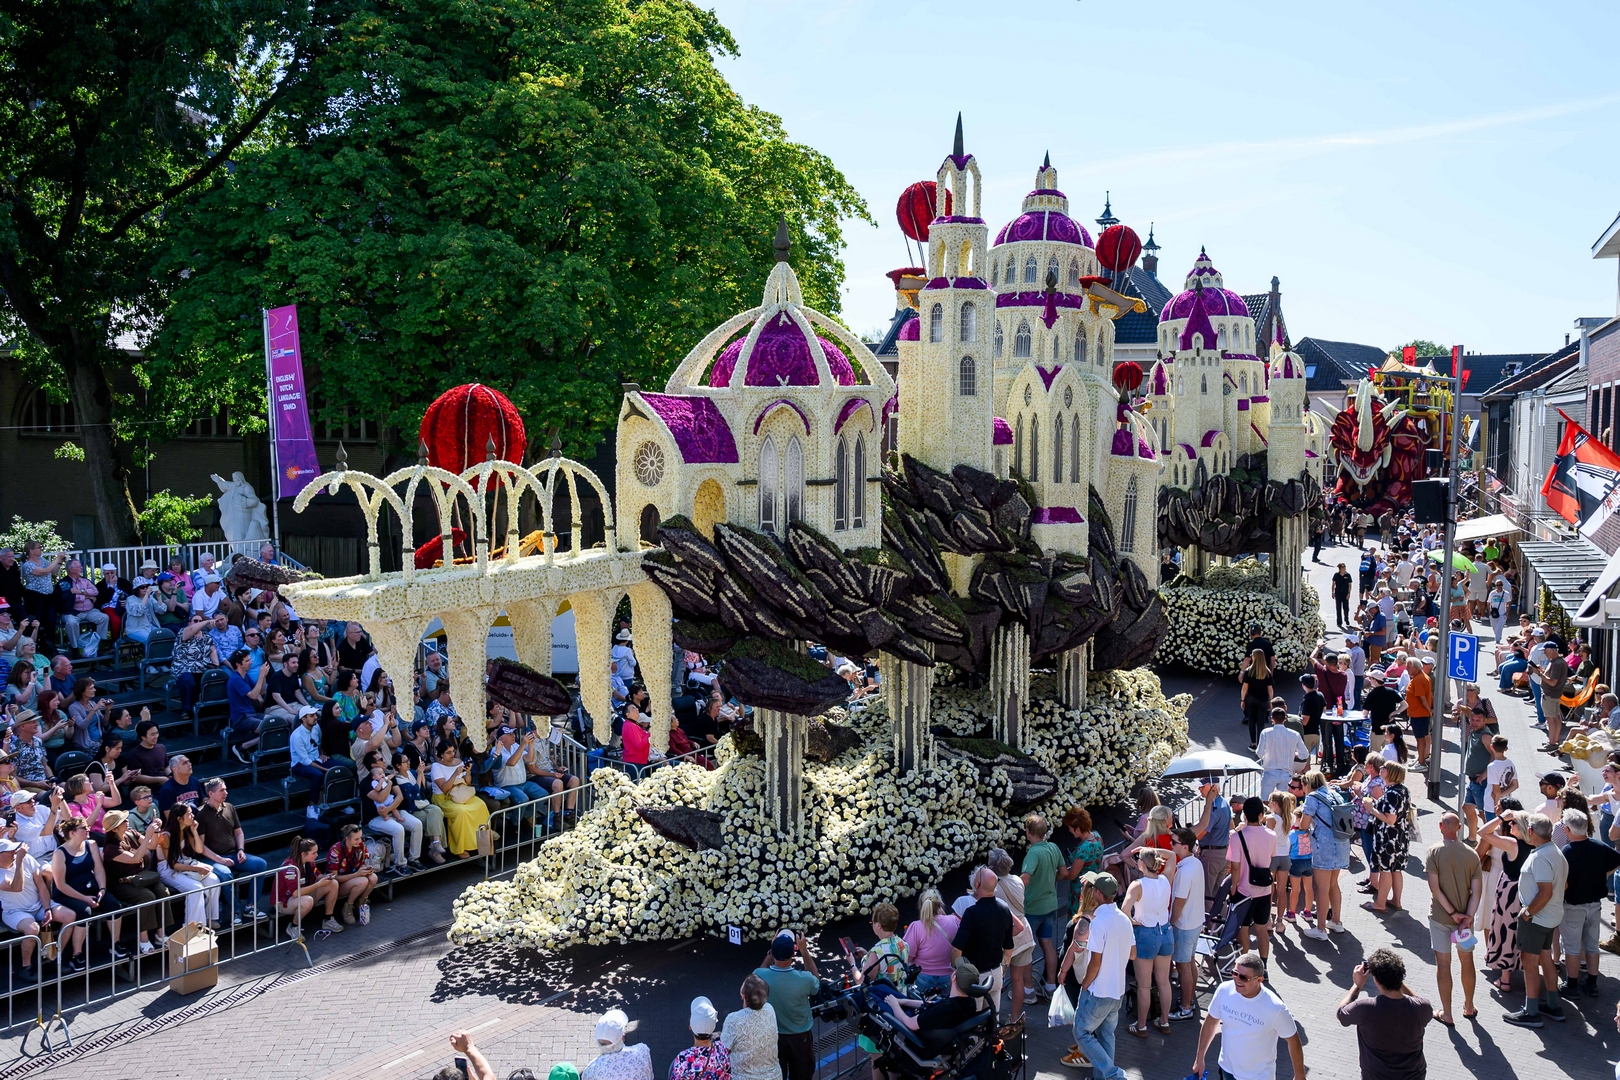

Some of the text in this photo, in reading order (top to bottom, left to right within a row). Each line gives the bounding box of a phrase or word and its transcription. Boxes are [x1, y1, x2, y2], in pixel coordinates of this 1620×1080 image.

[278, 393, 300, 402] LANGUAGE
[1455, 637, 1471, 660] P
[730, 928, 740, 939] 01
[1222, 1004, 1239, 1016] Marc
[1240, 1012, 1264, 1026] O'Polo
